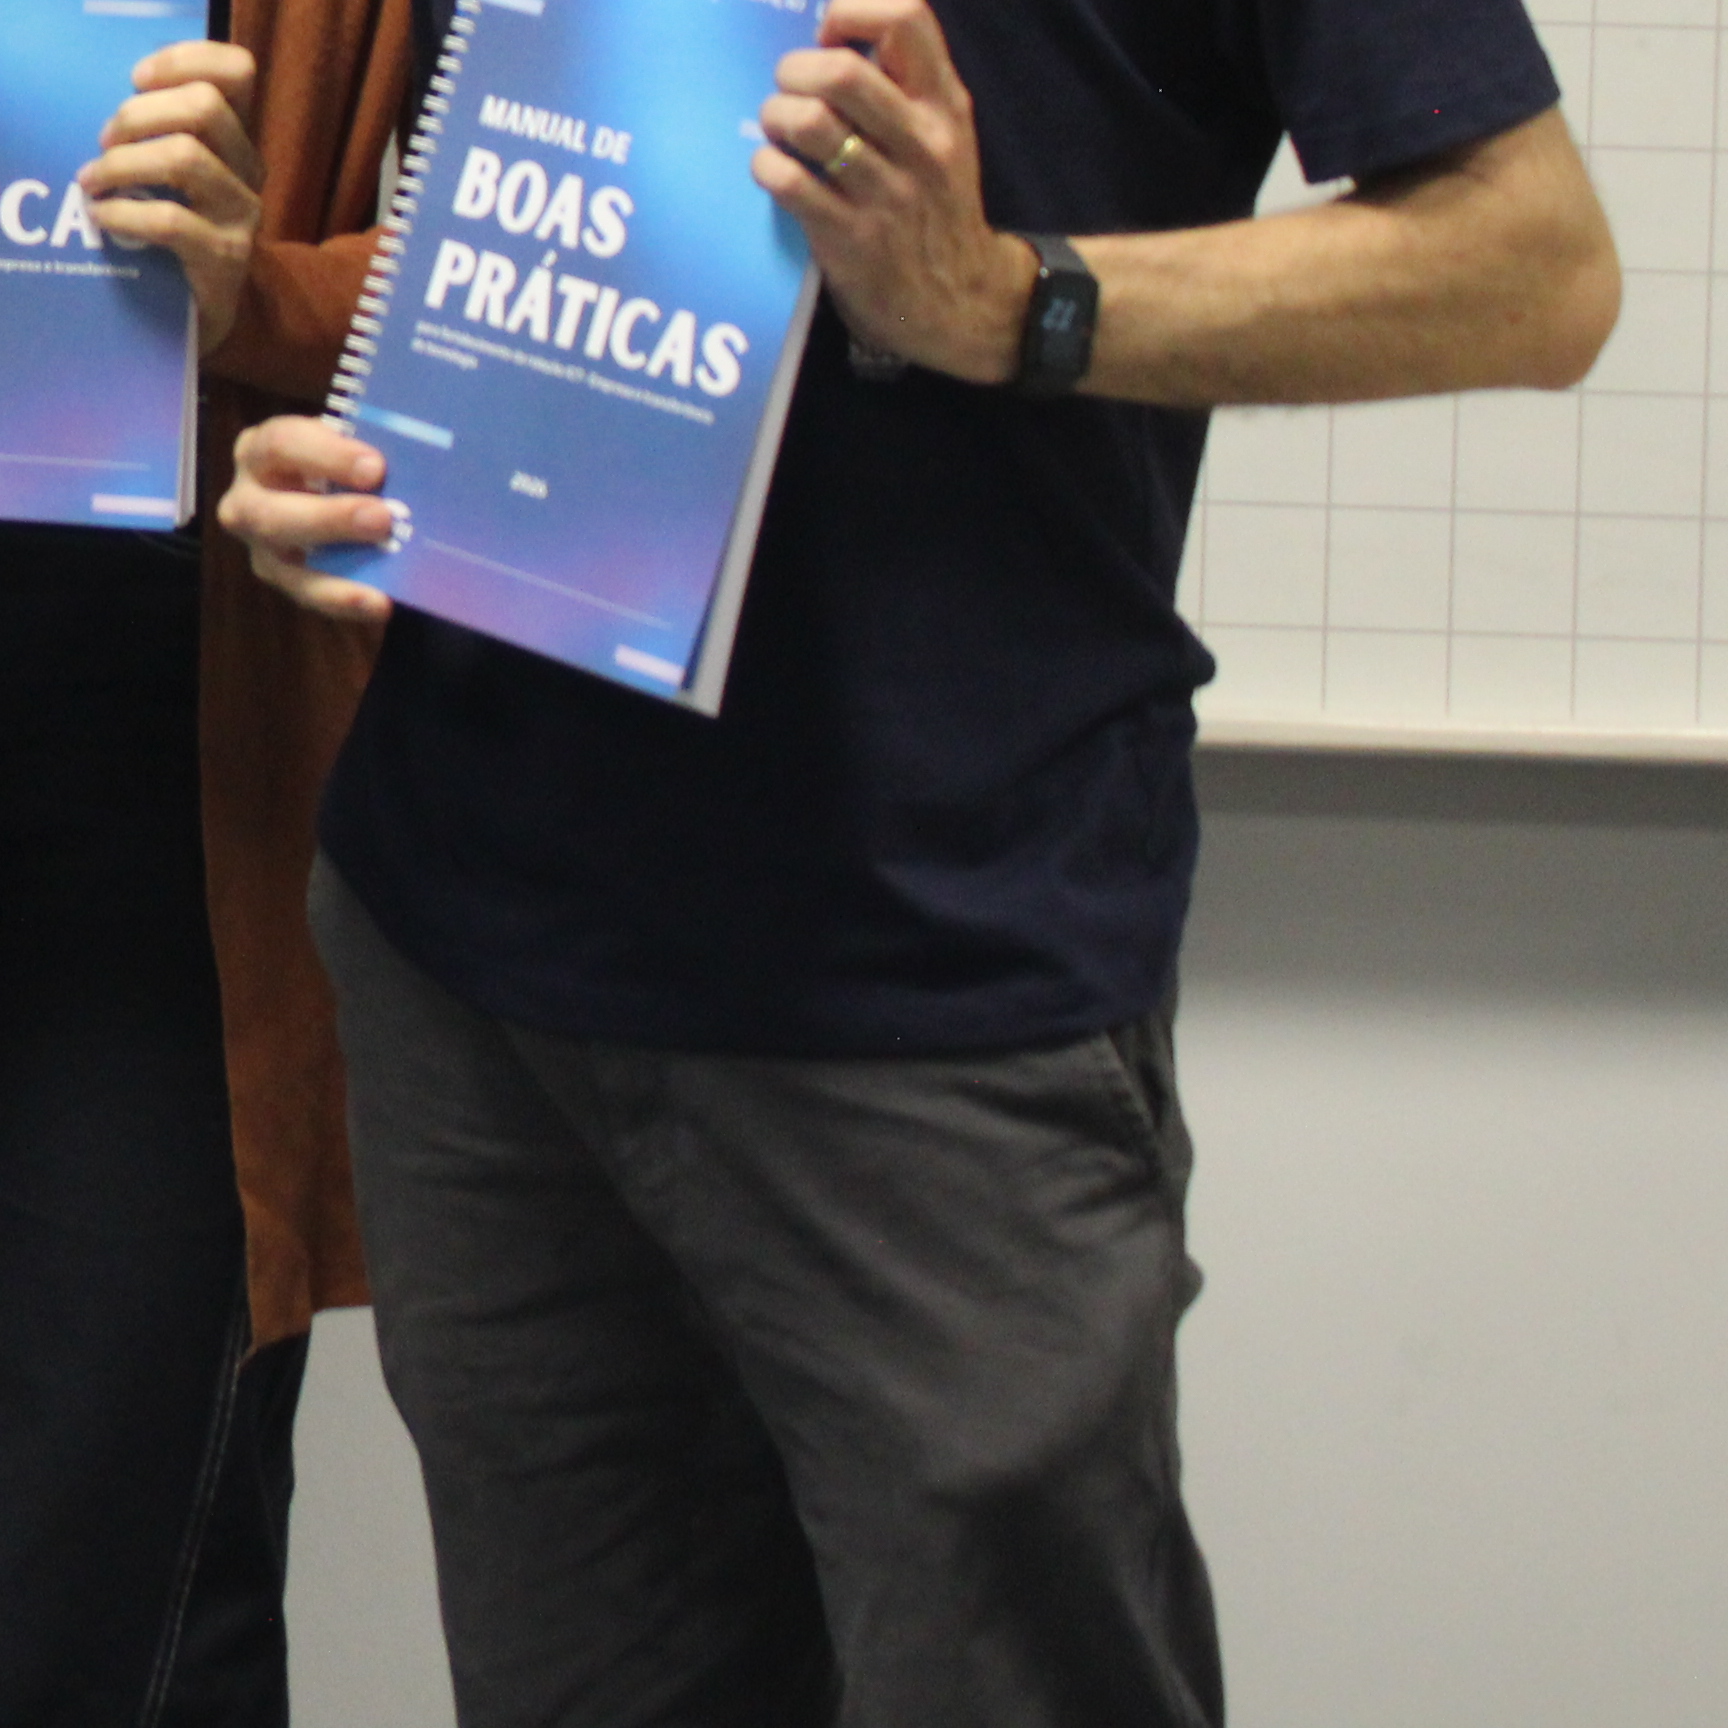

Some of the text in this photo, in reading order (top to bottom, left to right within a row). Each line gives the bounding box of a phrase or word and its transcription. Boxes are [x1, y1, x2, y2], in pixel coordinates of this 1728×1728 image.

[478, 94, 633, 165] MANUAL DE
[452, 146, 634, 259] BOAS
[424, 249, 749, 398] PRÁTICAS
